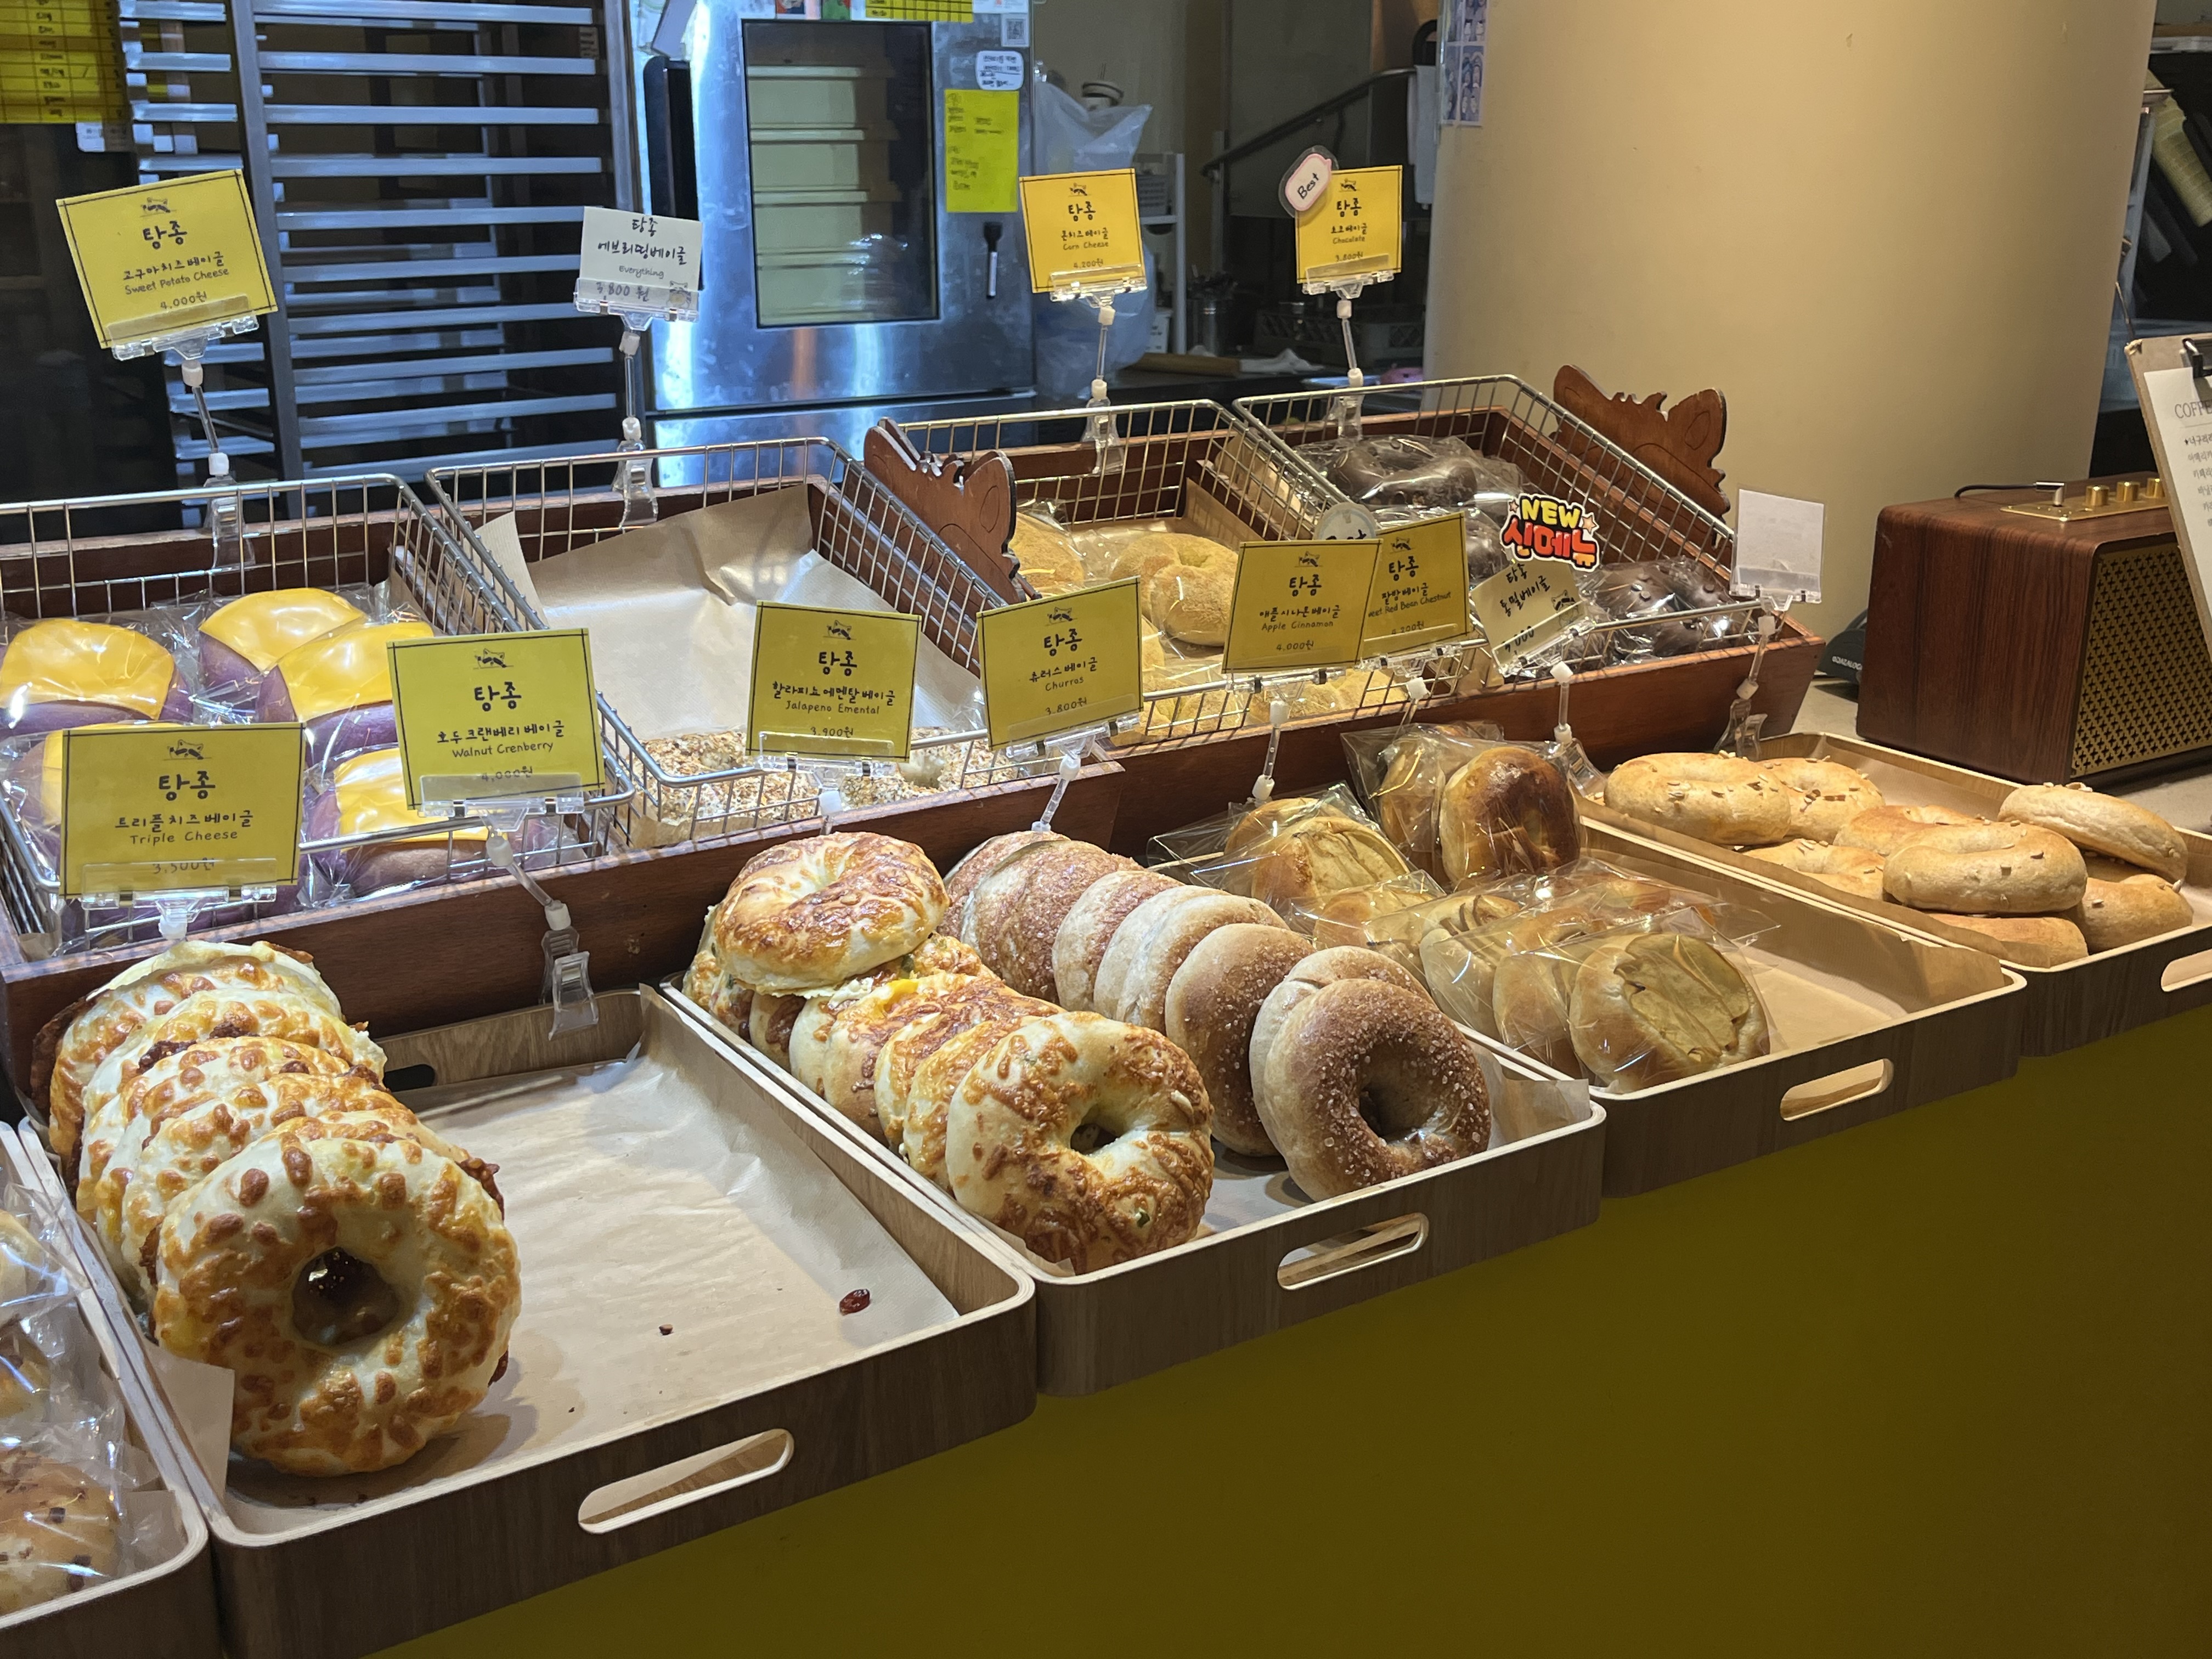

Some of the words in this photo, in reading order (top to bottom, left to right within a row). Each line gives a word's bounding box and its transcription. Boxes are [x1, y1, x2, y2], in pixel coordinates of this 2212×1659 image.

[1297, 172, 1319, 200] Best
[1068, 201, 1096, 222] 탕종
[1336, 198, 1362, 217] 탕종
[143, 221, 187, 250] 탕종
[632, 217, 658, 236] 탕종
[1333, 235, 1365, 244] Chocolate
[598, 240, 687, 266] 에브리띵베이글
[125, 280, 157, 295] Sweet
[160, 275, 191, 288] Potato
[194, 268, 229, 281] Cheese
[619, 266, 664, 279] Everything
[1521, 498, 1581, 529] NEW
[1503, 516, 1596, 567] 신메뉴
[1389, 556, 1419, 582] 탕종
[1506, 563, 1527, 584] 탕종
[1289, 574, 1322, 597] 탕종
[1385, 604, 1398, 614] Red
[1401, 601, 1418, 611] Bean
[1420, 591, 1451, 605] Chestnut
[1262, 623, 1286, 633] Apple
[1291, 621, 1334, 629] Cinnamon
[1044, 629, 1082, 656] 탕종
[819, 651, 857, 676] 탕종
[1045, 676, 1084, 691] Churros
[474, 681, 522, 712] 탕종
[786, 701, 832, 713] Jalapeno
[838, 703, 879, 714] Emental
[452, 746, 493, 758] Walnut
[497, 742, 554, 754] Crenberry
[159, 770, 216, 801] 탕종
[115, 810, 253, 833] 트리플치즈베이글
[130, 833, 176, 847] Triple
[184, 830, 238, 842] Cheese
